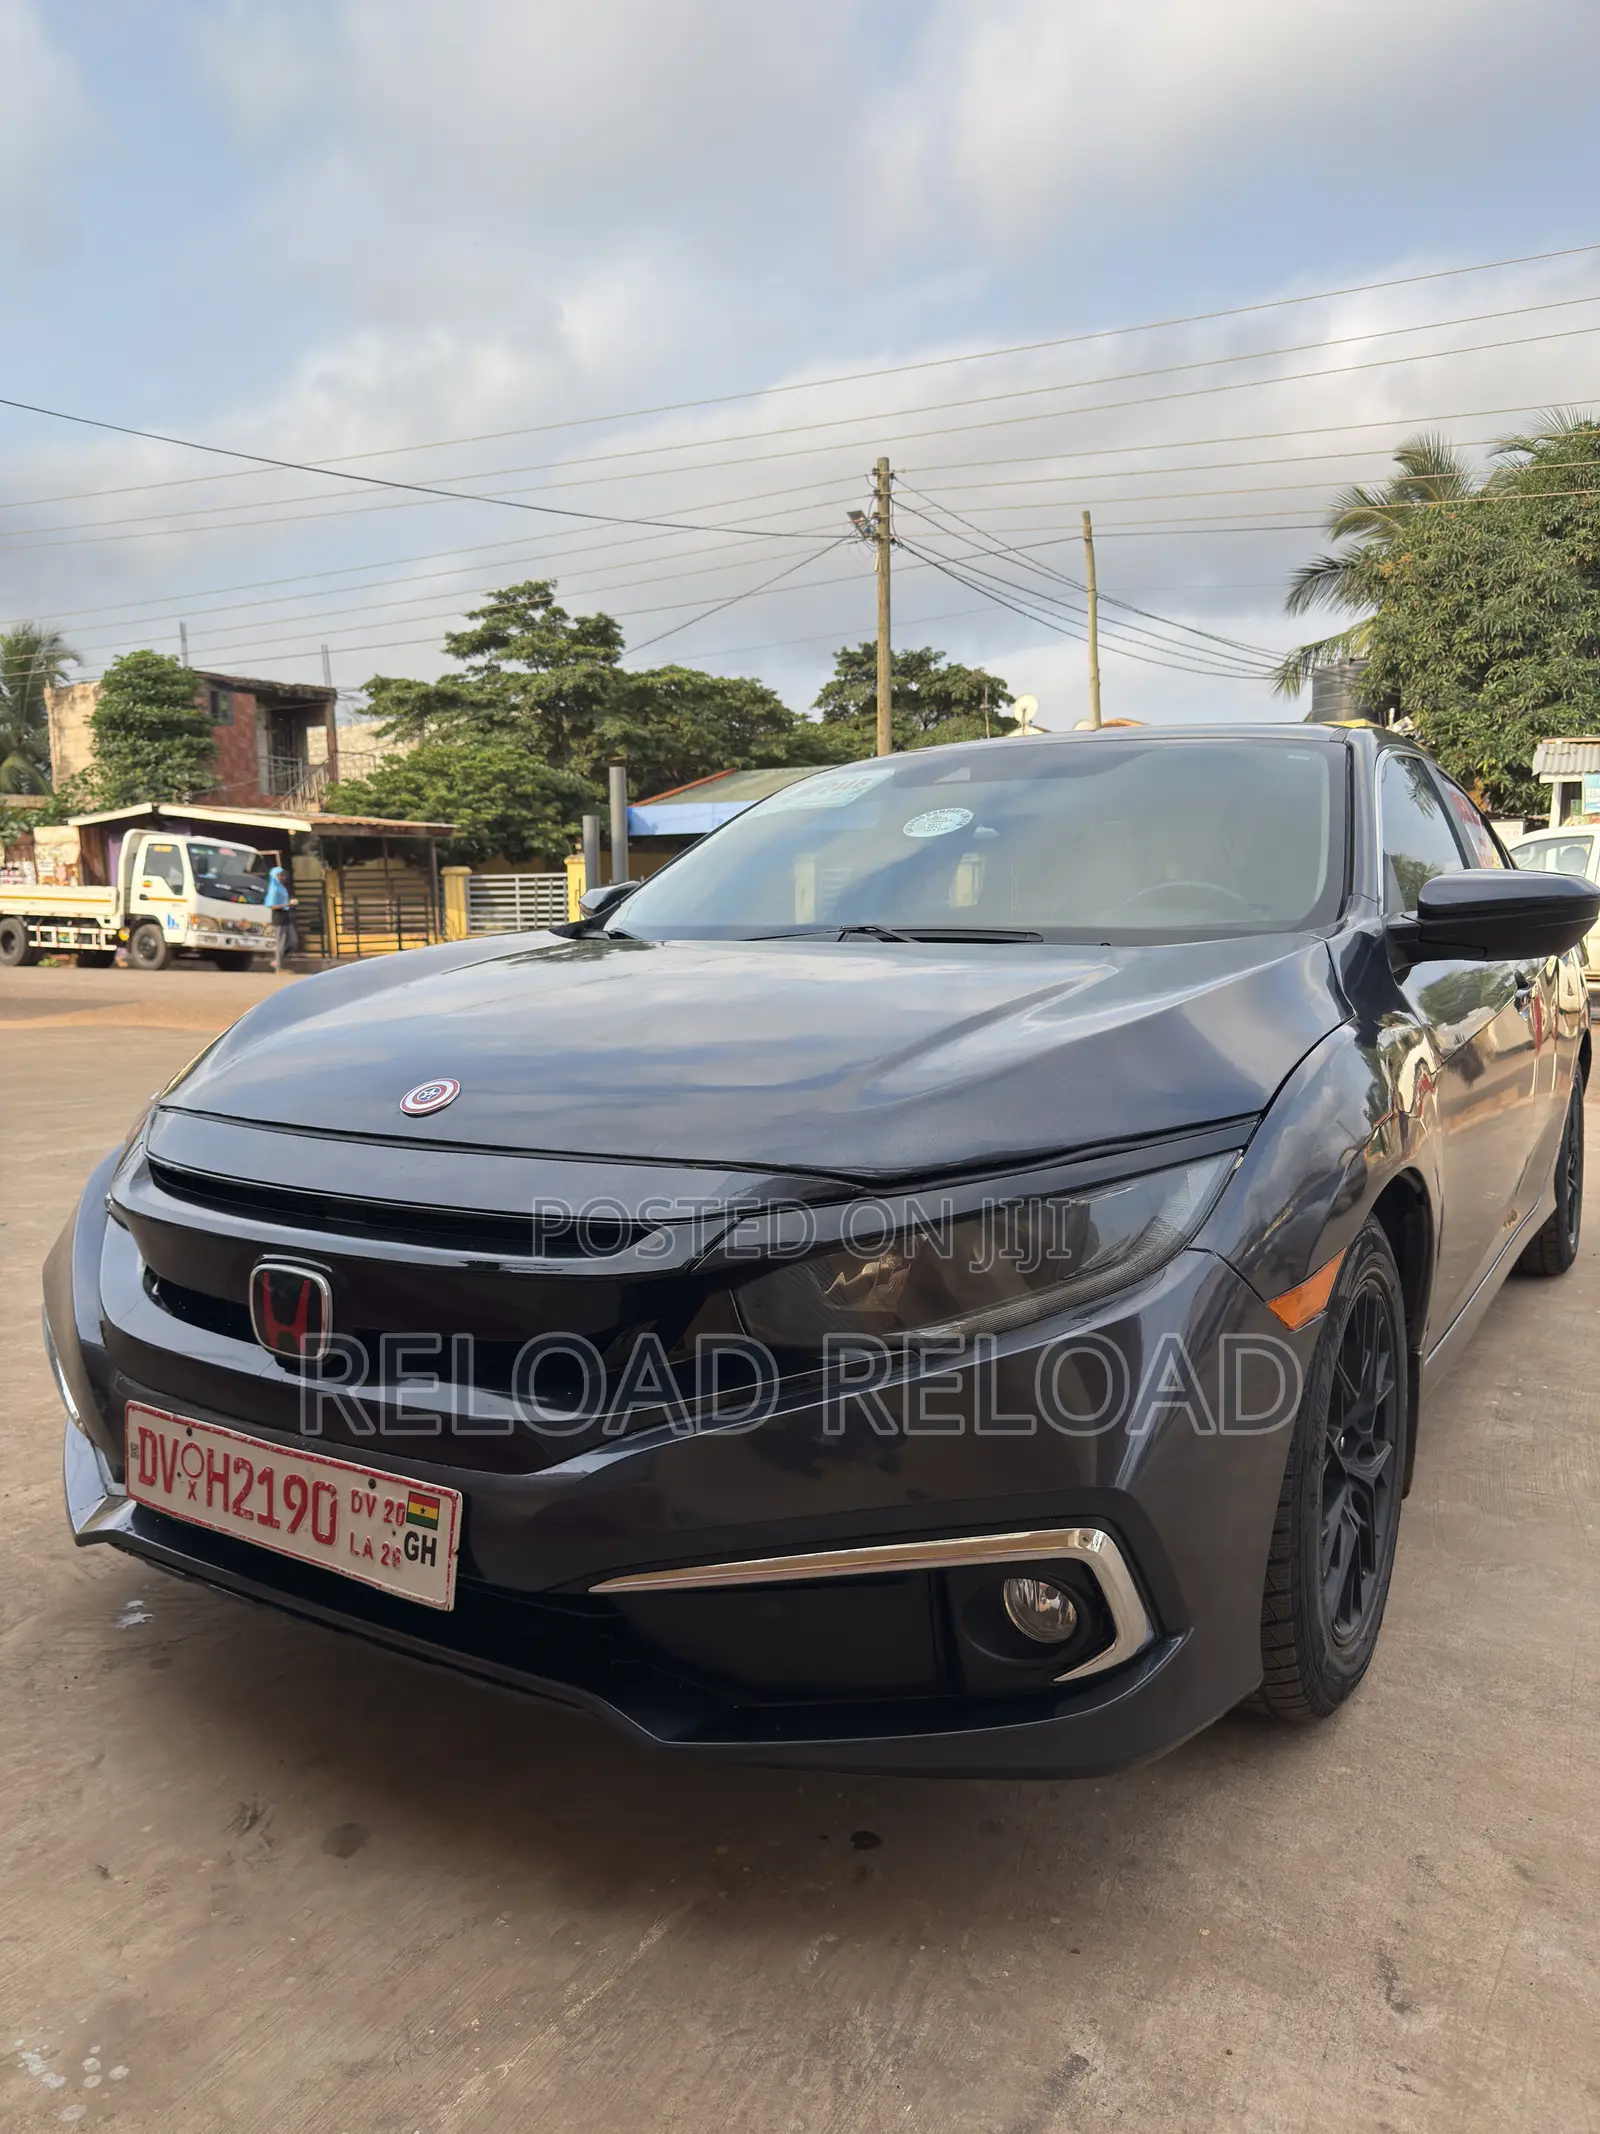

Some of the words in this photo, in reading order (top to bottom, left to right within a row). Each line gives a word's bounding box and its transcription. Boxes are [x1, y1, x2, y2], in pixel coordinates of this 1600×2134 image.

[351, 1488, 377, 1518] DV
[383, 1498, 406, 1527] 20
[349, 1531, 374, 1560] LA
[404, 1530, 438, 1568] GH
